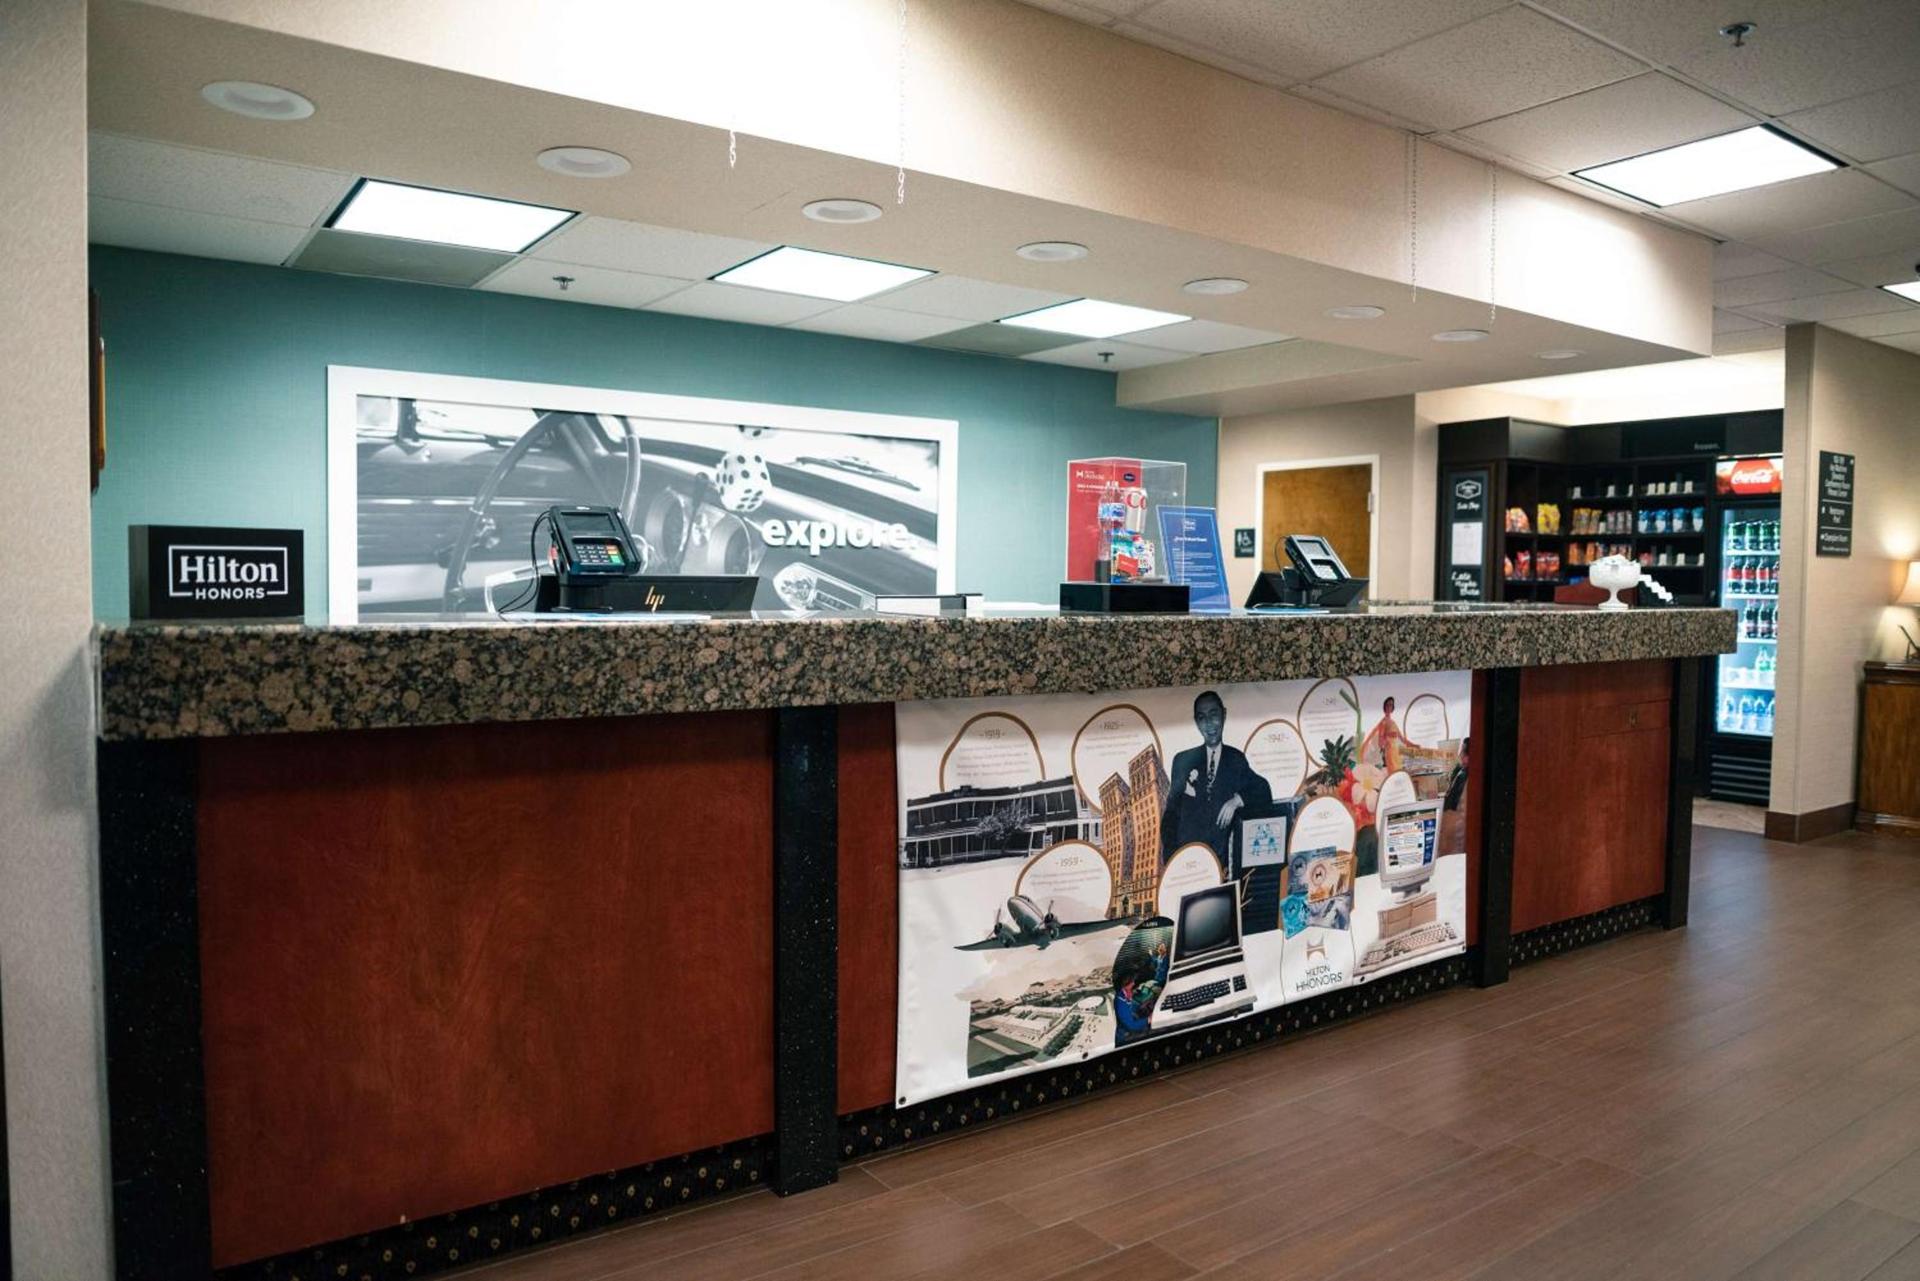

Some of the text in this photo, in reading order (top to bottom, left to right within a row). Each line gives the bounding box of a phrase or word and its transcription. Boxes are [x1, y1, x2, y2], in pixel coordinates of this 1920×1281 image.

[1731, 469, 1772, 485] Coca-Cola
[179, 555, 279, 583] Hilton
[195, 587, 265, 600] HONORS
[645, 586, 665, 612] hp
